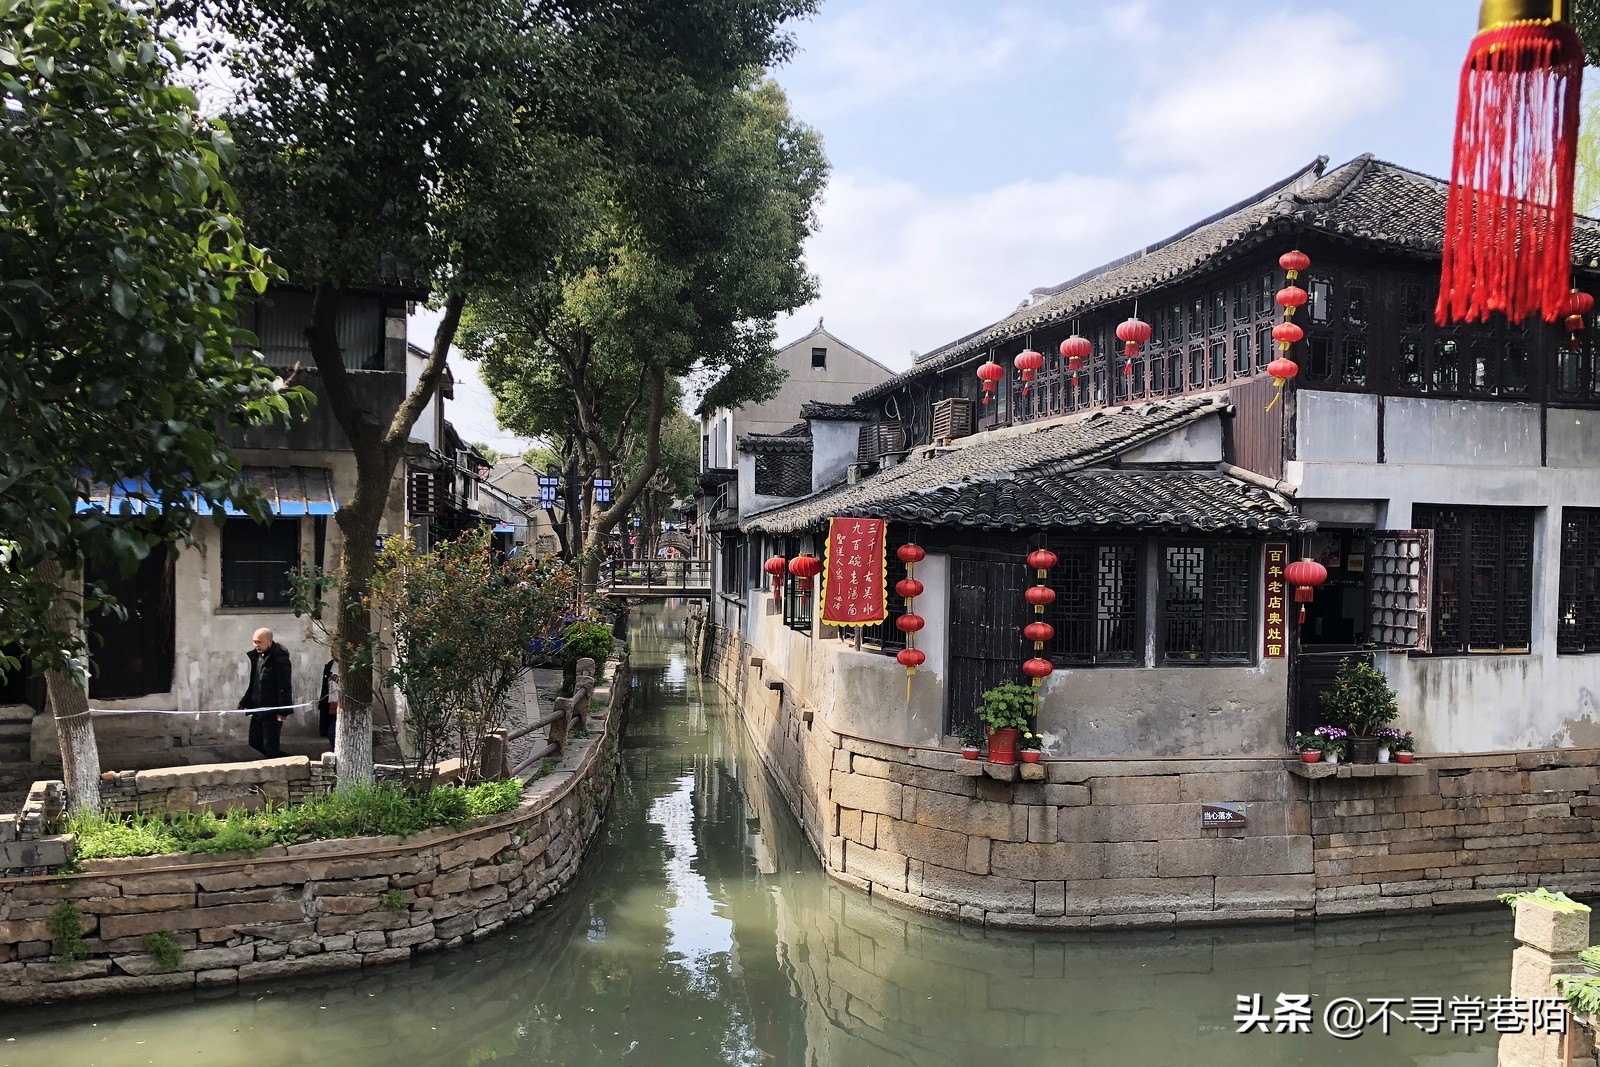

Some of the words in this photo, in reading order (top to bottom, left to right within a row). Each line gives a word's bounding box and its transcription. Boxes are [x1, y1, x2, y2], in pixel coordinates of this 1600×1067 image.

[1267, 550, 1283, 656] 百年老店奥灶面
[1204, 811, 1233, 820] 当心落水
